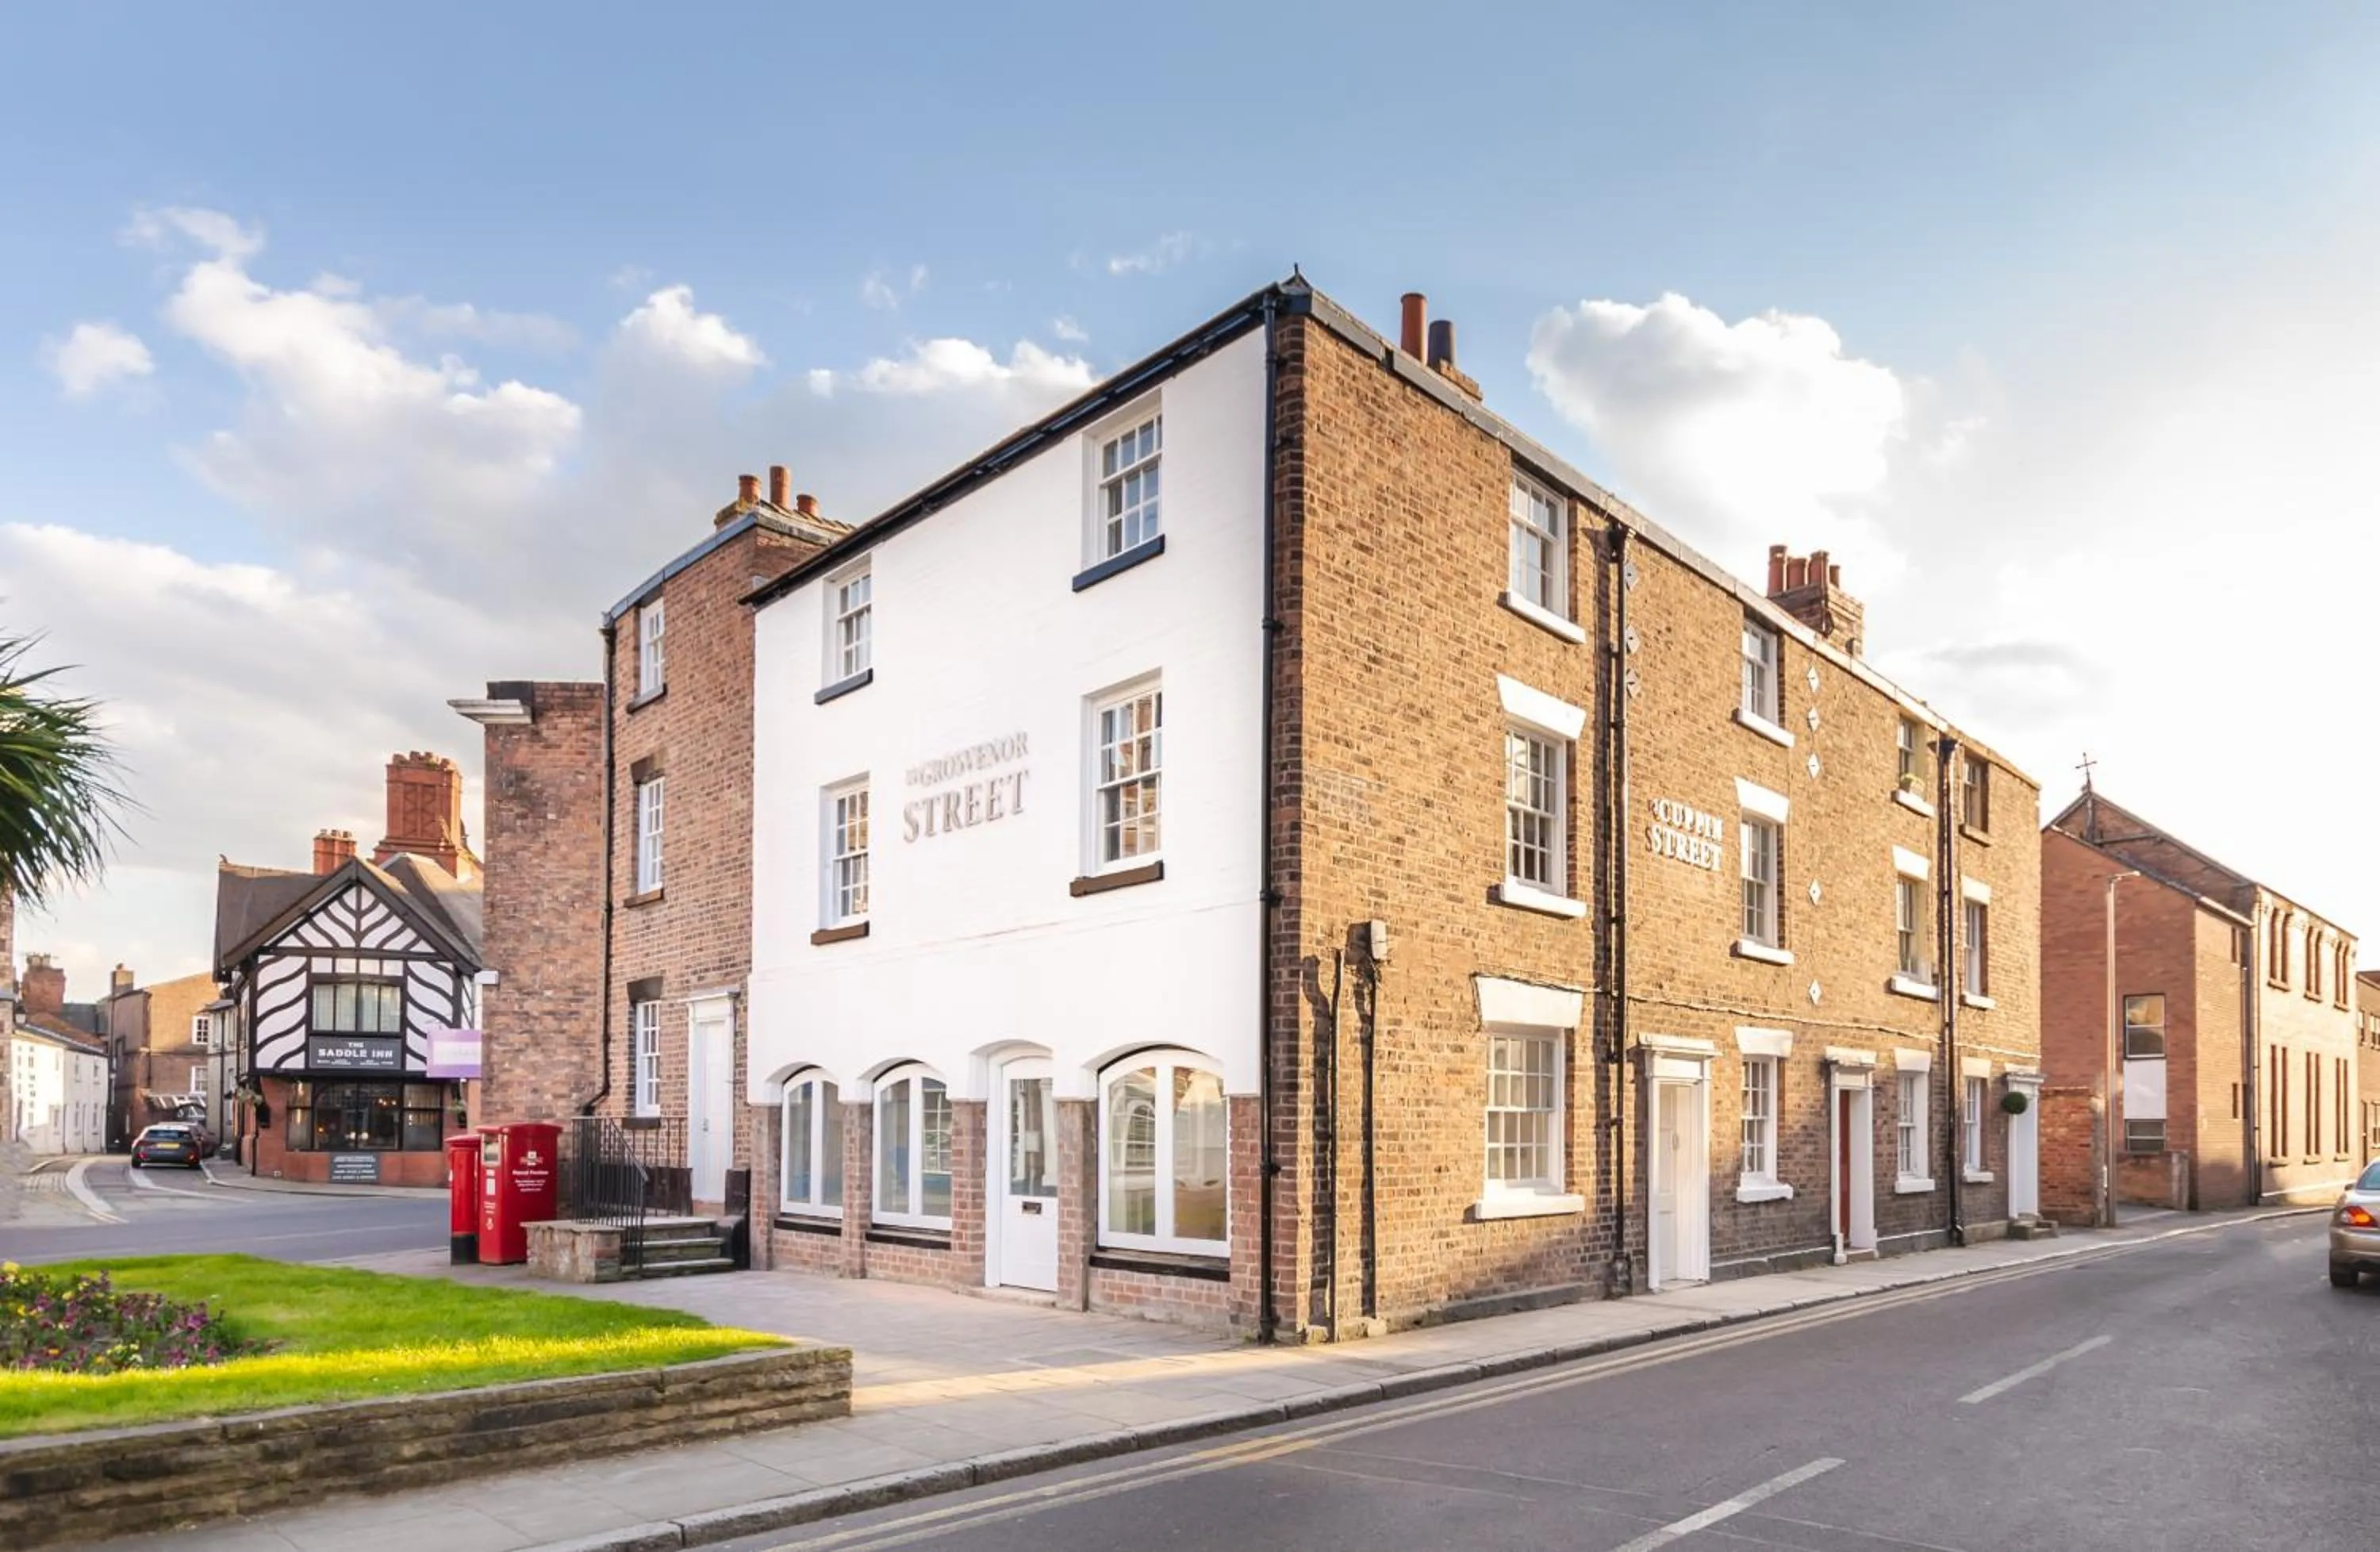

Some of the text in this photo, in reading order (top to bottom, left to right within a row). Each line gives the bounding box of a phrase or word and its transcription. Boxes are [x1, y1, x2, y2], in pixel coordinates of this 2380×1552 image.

[920, 731, 1029, 787] GROSVENOR
[903, 769, 1031, 844] STREET
[1649, 824, 1723, 872] STREET
[318, 1048, 393, 1058] SADDLE INN
